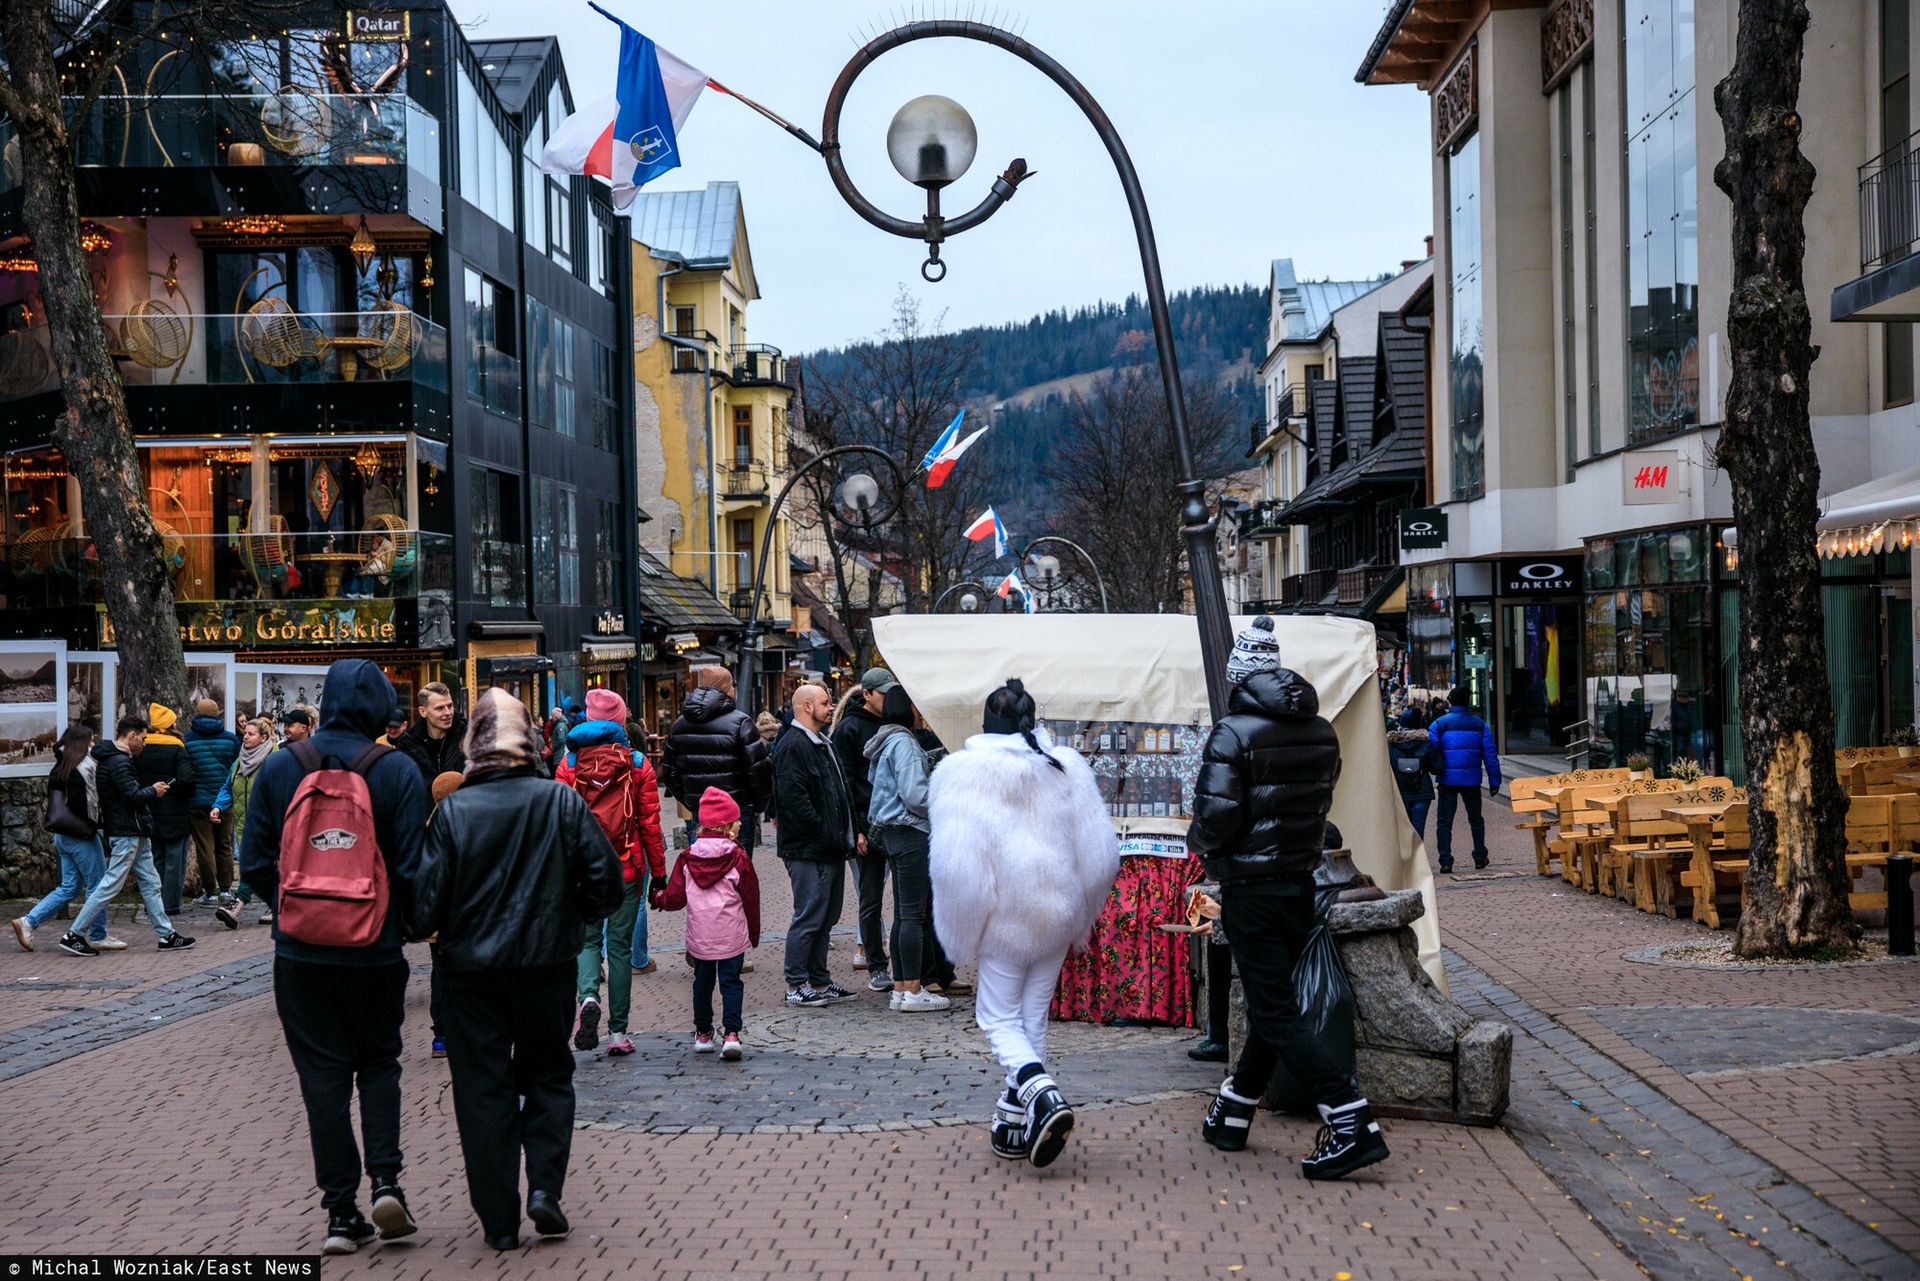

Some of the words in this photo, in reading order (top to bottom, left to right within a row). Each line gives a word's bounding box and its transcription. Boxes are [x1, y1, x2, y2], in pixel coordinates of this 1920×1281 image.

[356, 16, 400, 32] Qatar
[1634, 465, 1668, 488] H&M
[1510, 580, 1573, 589] OAKLEY
[256, 612, 396, 640] Góralskie
[1120, 843, 1139, 851] VISA
